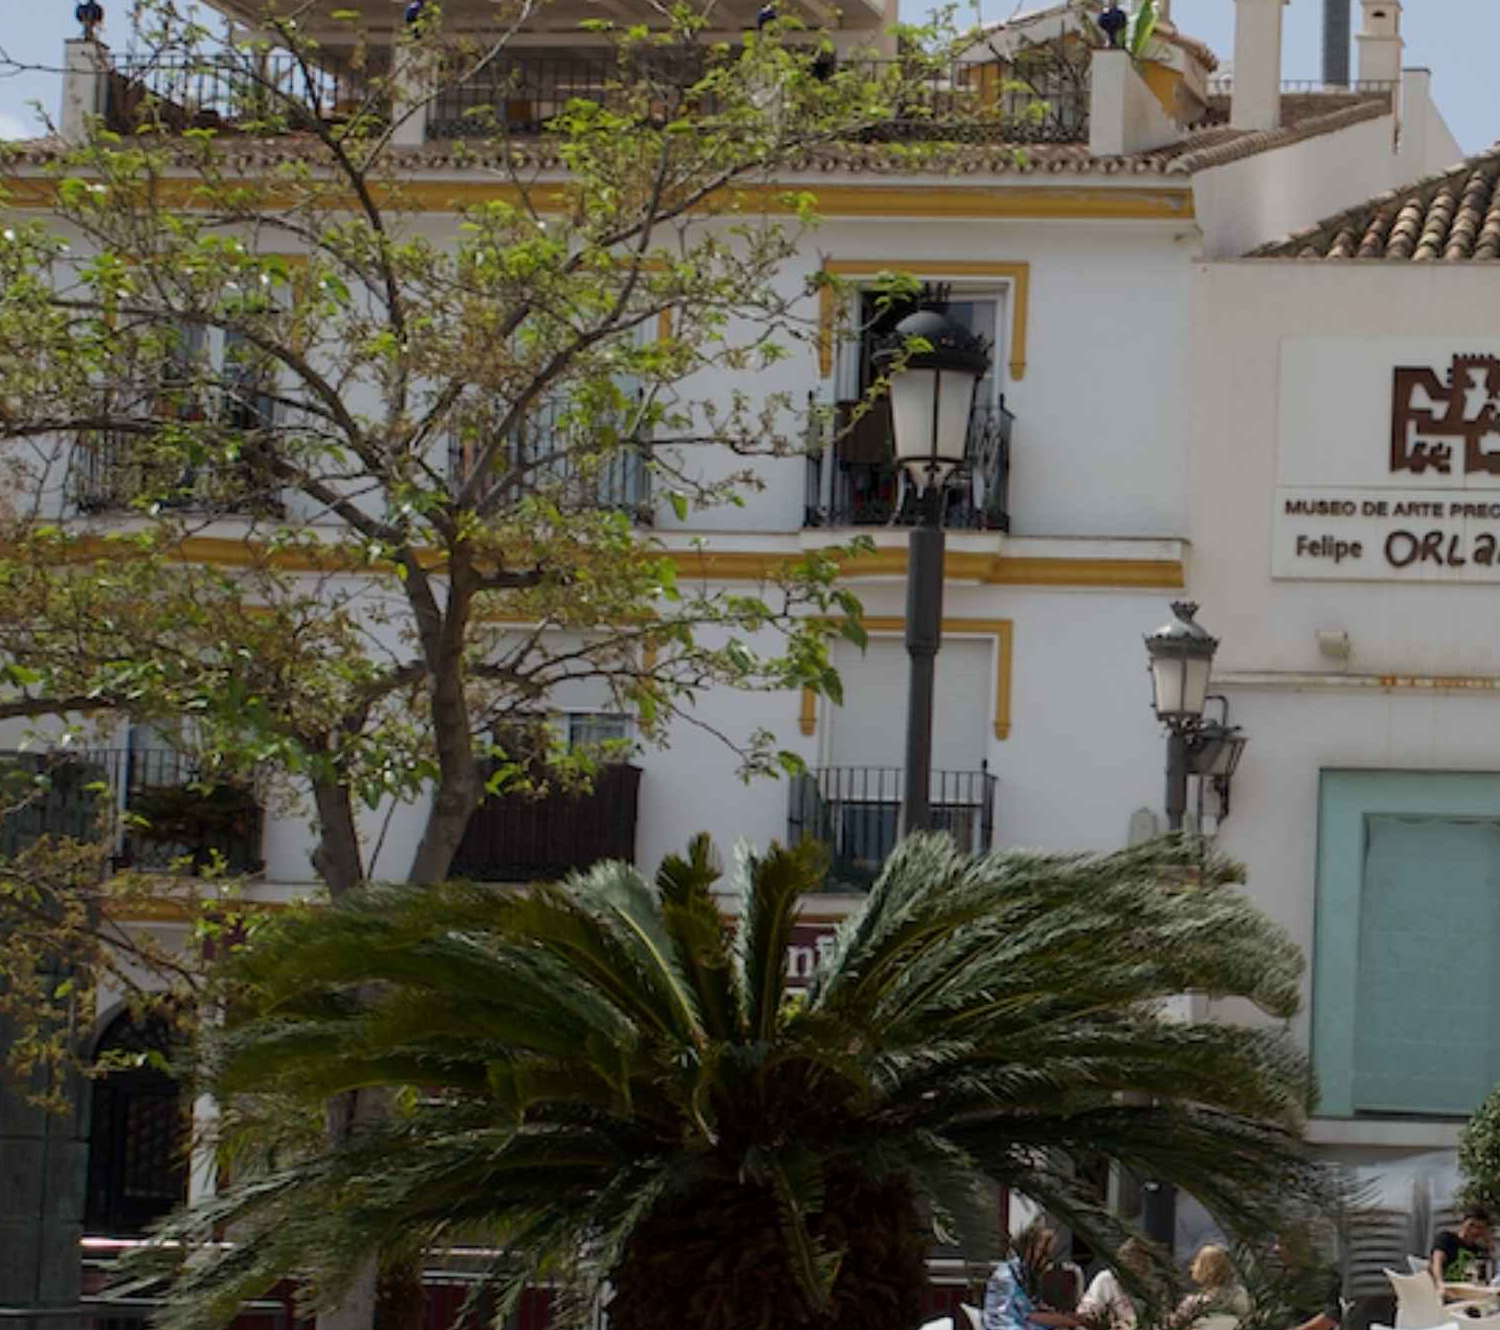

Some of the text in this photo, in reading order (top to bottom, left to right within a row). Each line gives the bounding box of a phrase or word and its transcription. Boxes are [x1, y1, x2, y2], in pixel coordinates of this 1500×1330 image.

[1285, 500, 1357, 518] MUSEO
[1362, 501, 1389, 518] DE
[1393, 501, 1443, 519] ARTE
[1296, 535, 1363, 562] Felipe
